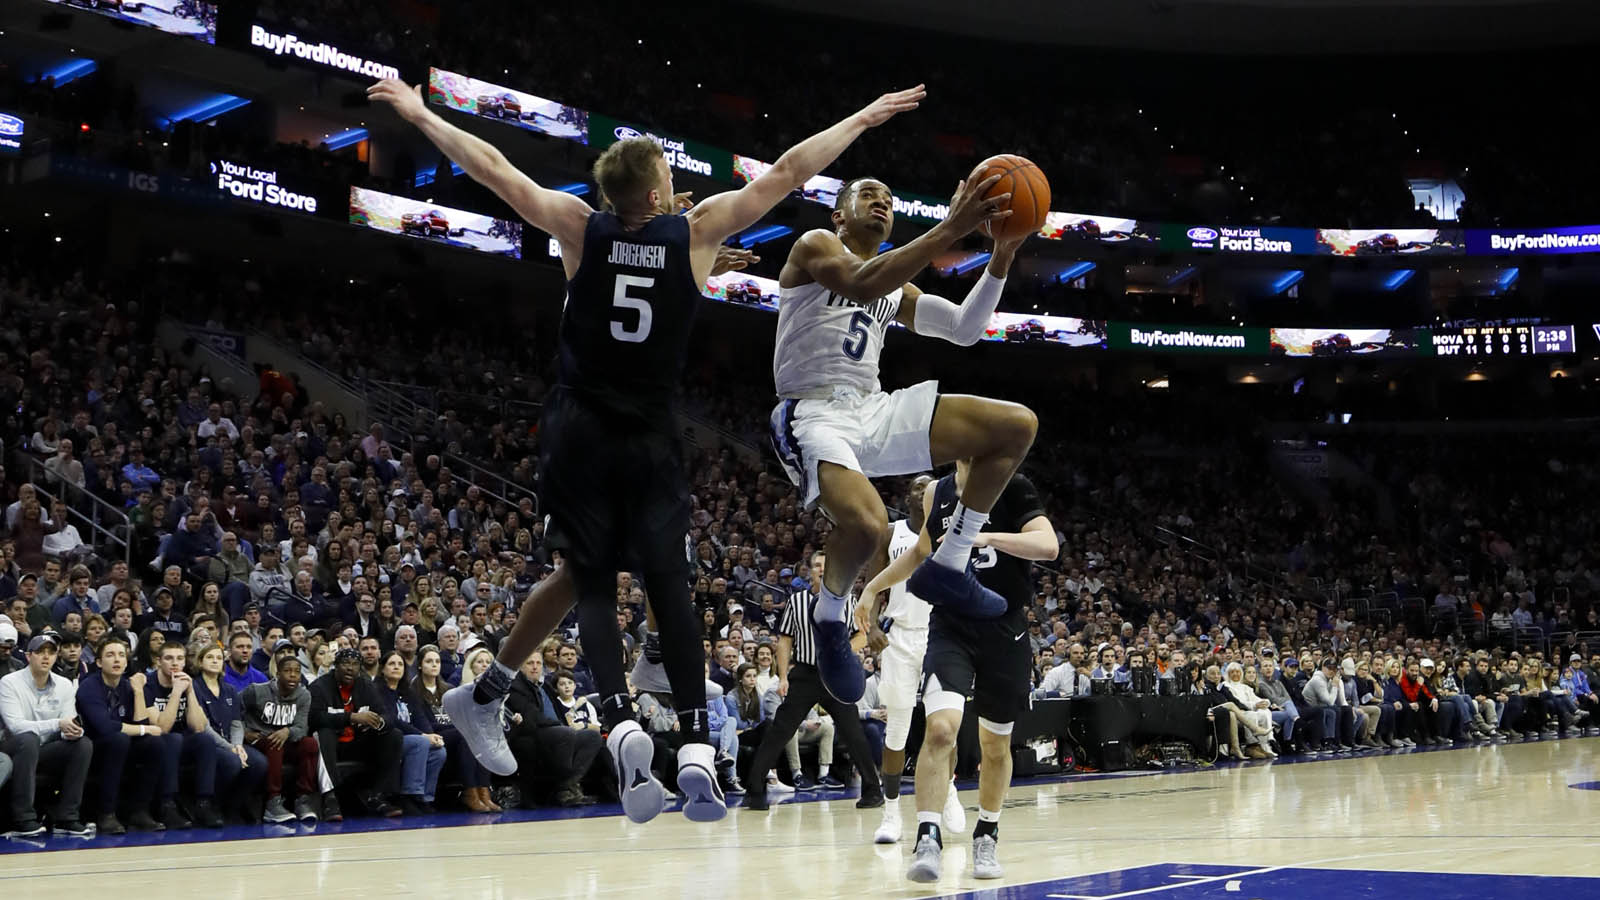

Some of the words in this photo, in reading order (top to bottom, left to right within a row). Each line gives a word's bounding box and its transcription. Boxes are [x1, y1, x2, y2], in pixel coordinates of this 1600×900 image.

[251, 24, 399, 80] BuyFordNow.com
[664, 137, 684, 152] Local
[220, 160, 246, 178] Your
[246, 166, 277, 184] Local
[676, 152, 712, 176] Store
[218, 173, 263, 201] Ford
[264, 184, 317, 213] Store
[1220, 227, 1238, 237] Your
[1239, 228, 1261, 237] Local
[608, 240, 666, 270] JORGENSEN
[1220, 236, 1252, 251] Ford
[1253, 238, 1292, 252] Store
[610, 273, 655, 343] 5
[842, 310, 874, 362] 5
[1131, 328, 1245, 348] BuyFordNow.com
[1432, 335, 1464, 345] NOVA
[1484, 334, 1492, 344] 2
[1502, 334, 1510, 343] 0
[1519, 334, 1527, 343] 0
[1437, 345, 1461, 355] BUT
[1465, 345, 1477, 355] 11
[1503, 344, 1510, 354] 0
[1520, 344, 1528, 353] 2
[1546, 343, 1561, 352] PM
